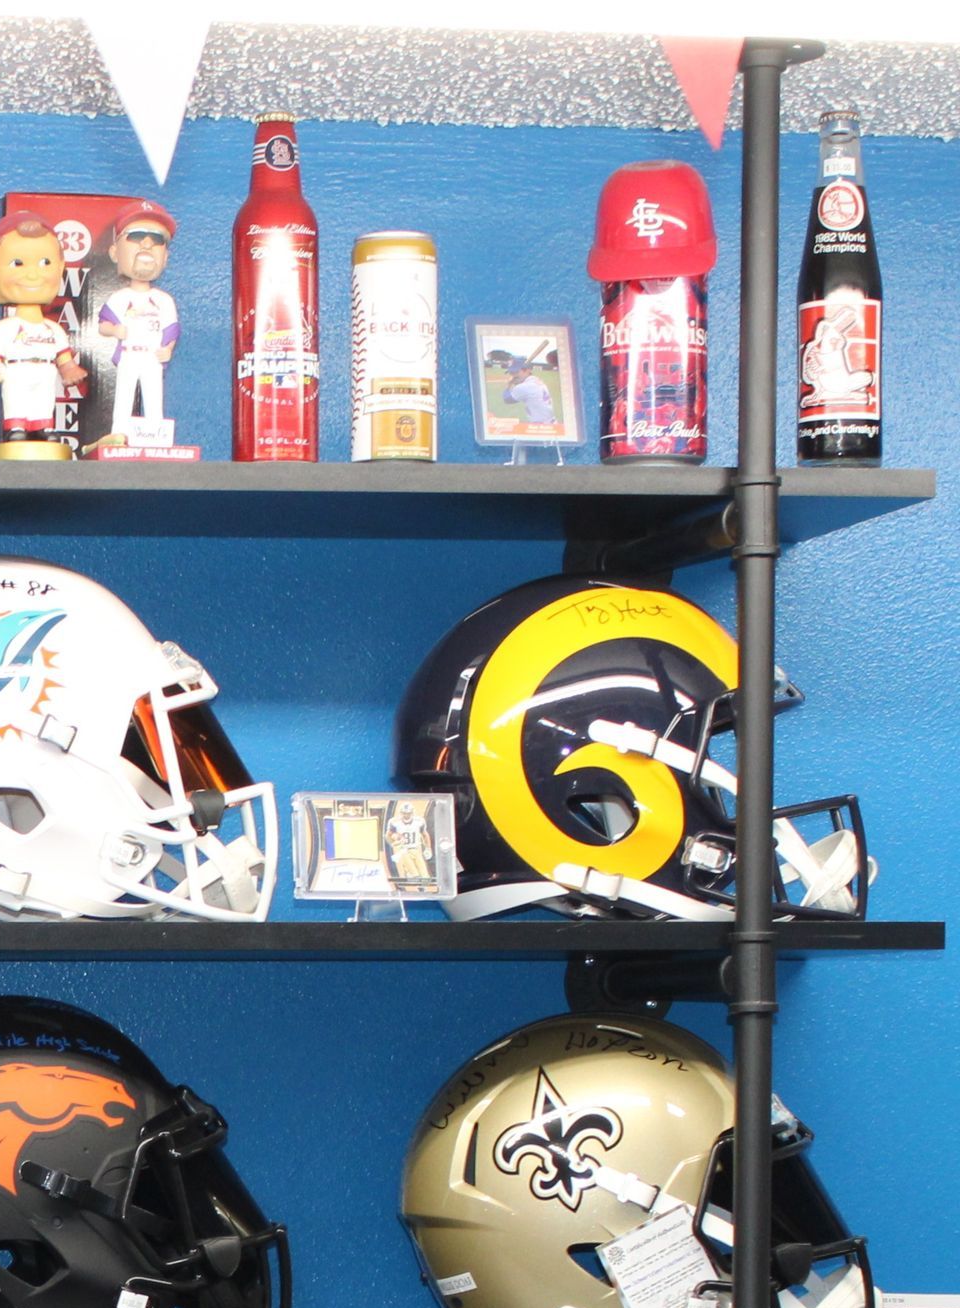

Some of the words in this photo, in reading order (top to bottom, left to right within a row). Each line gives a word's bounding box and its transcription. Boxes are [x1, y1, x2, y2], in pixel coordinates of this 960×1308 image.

[815, 232, 837, 243] 1982
[838, 231, 866, 243] World
[813, 243, 867, 254] Champions
